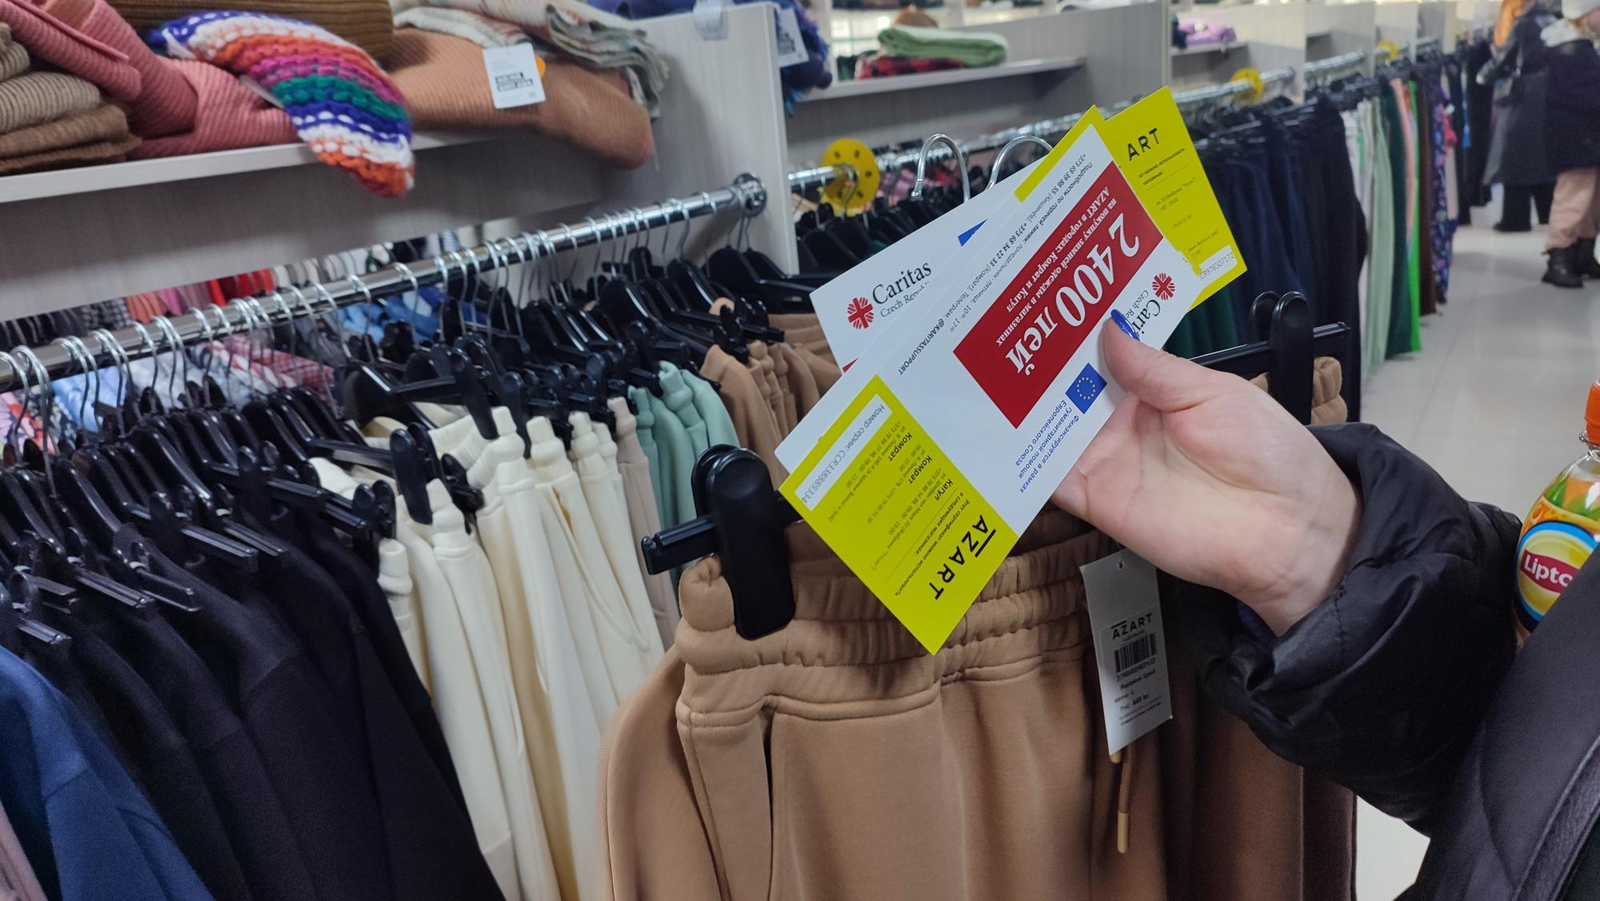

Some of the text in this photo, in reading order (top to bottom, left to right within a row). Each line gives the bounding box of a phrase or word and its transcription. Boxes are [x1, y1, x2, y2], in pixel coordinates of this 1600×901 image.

[1128, 127, 1160, 160] ART
[1062, 160, 1093, 197] Подробности
[1037, 200, 1058, 226] горячей
[1055, 194, 1064, 204] по
[1014, 221, 1028, 237] +373
[1021, 222, 1039, 244] линии:
[989, 256, 998, 266] 33
[991, 242, 1023, 279] понедельник
[995, 248, 1004, 259] 22
[1002, 241, 1011, 251] 34
[1004, 186, 1110, 313] AZART в городах: Комрат и Кагул
[872, 262, 932, 304] Caritas
[995, 197, 1117, 346] на покупку зимней одежды в магазинах
[880, 299, 903, 318] Czech
[1132, 288, 1149, 310] Czech
[1132, 297, 1161, 336] Cari
[896, 317, 945, 375] @KARITASSUPPORT
[1006, 307, 1057, 376] лей
[861, 401, 885, 429] Номер
[843, 425, 864, 451] серии:
[886, 430, 912, 462] Комрат
[1015, 399, 1066, 467] Европейского Союза
[1018, 405, 1073, 479] гуманитарной помощи
[1041, 413, 1080, 465] Финансируется
[906, 453, 932, 485] Комрат
[1019, 468, 1038, 494] рамках
[933, 477, 953, 502] Кагул
[928, 514, 991, 600] AZART
[1525, 554, 1574, 588] Lipto
[1111, 612, 1153, 640] AZART
